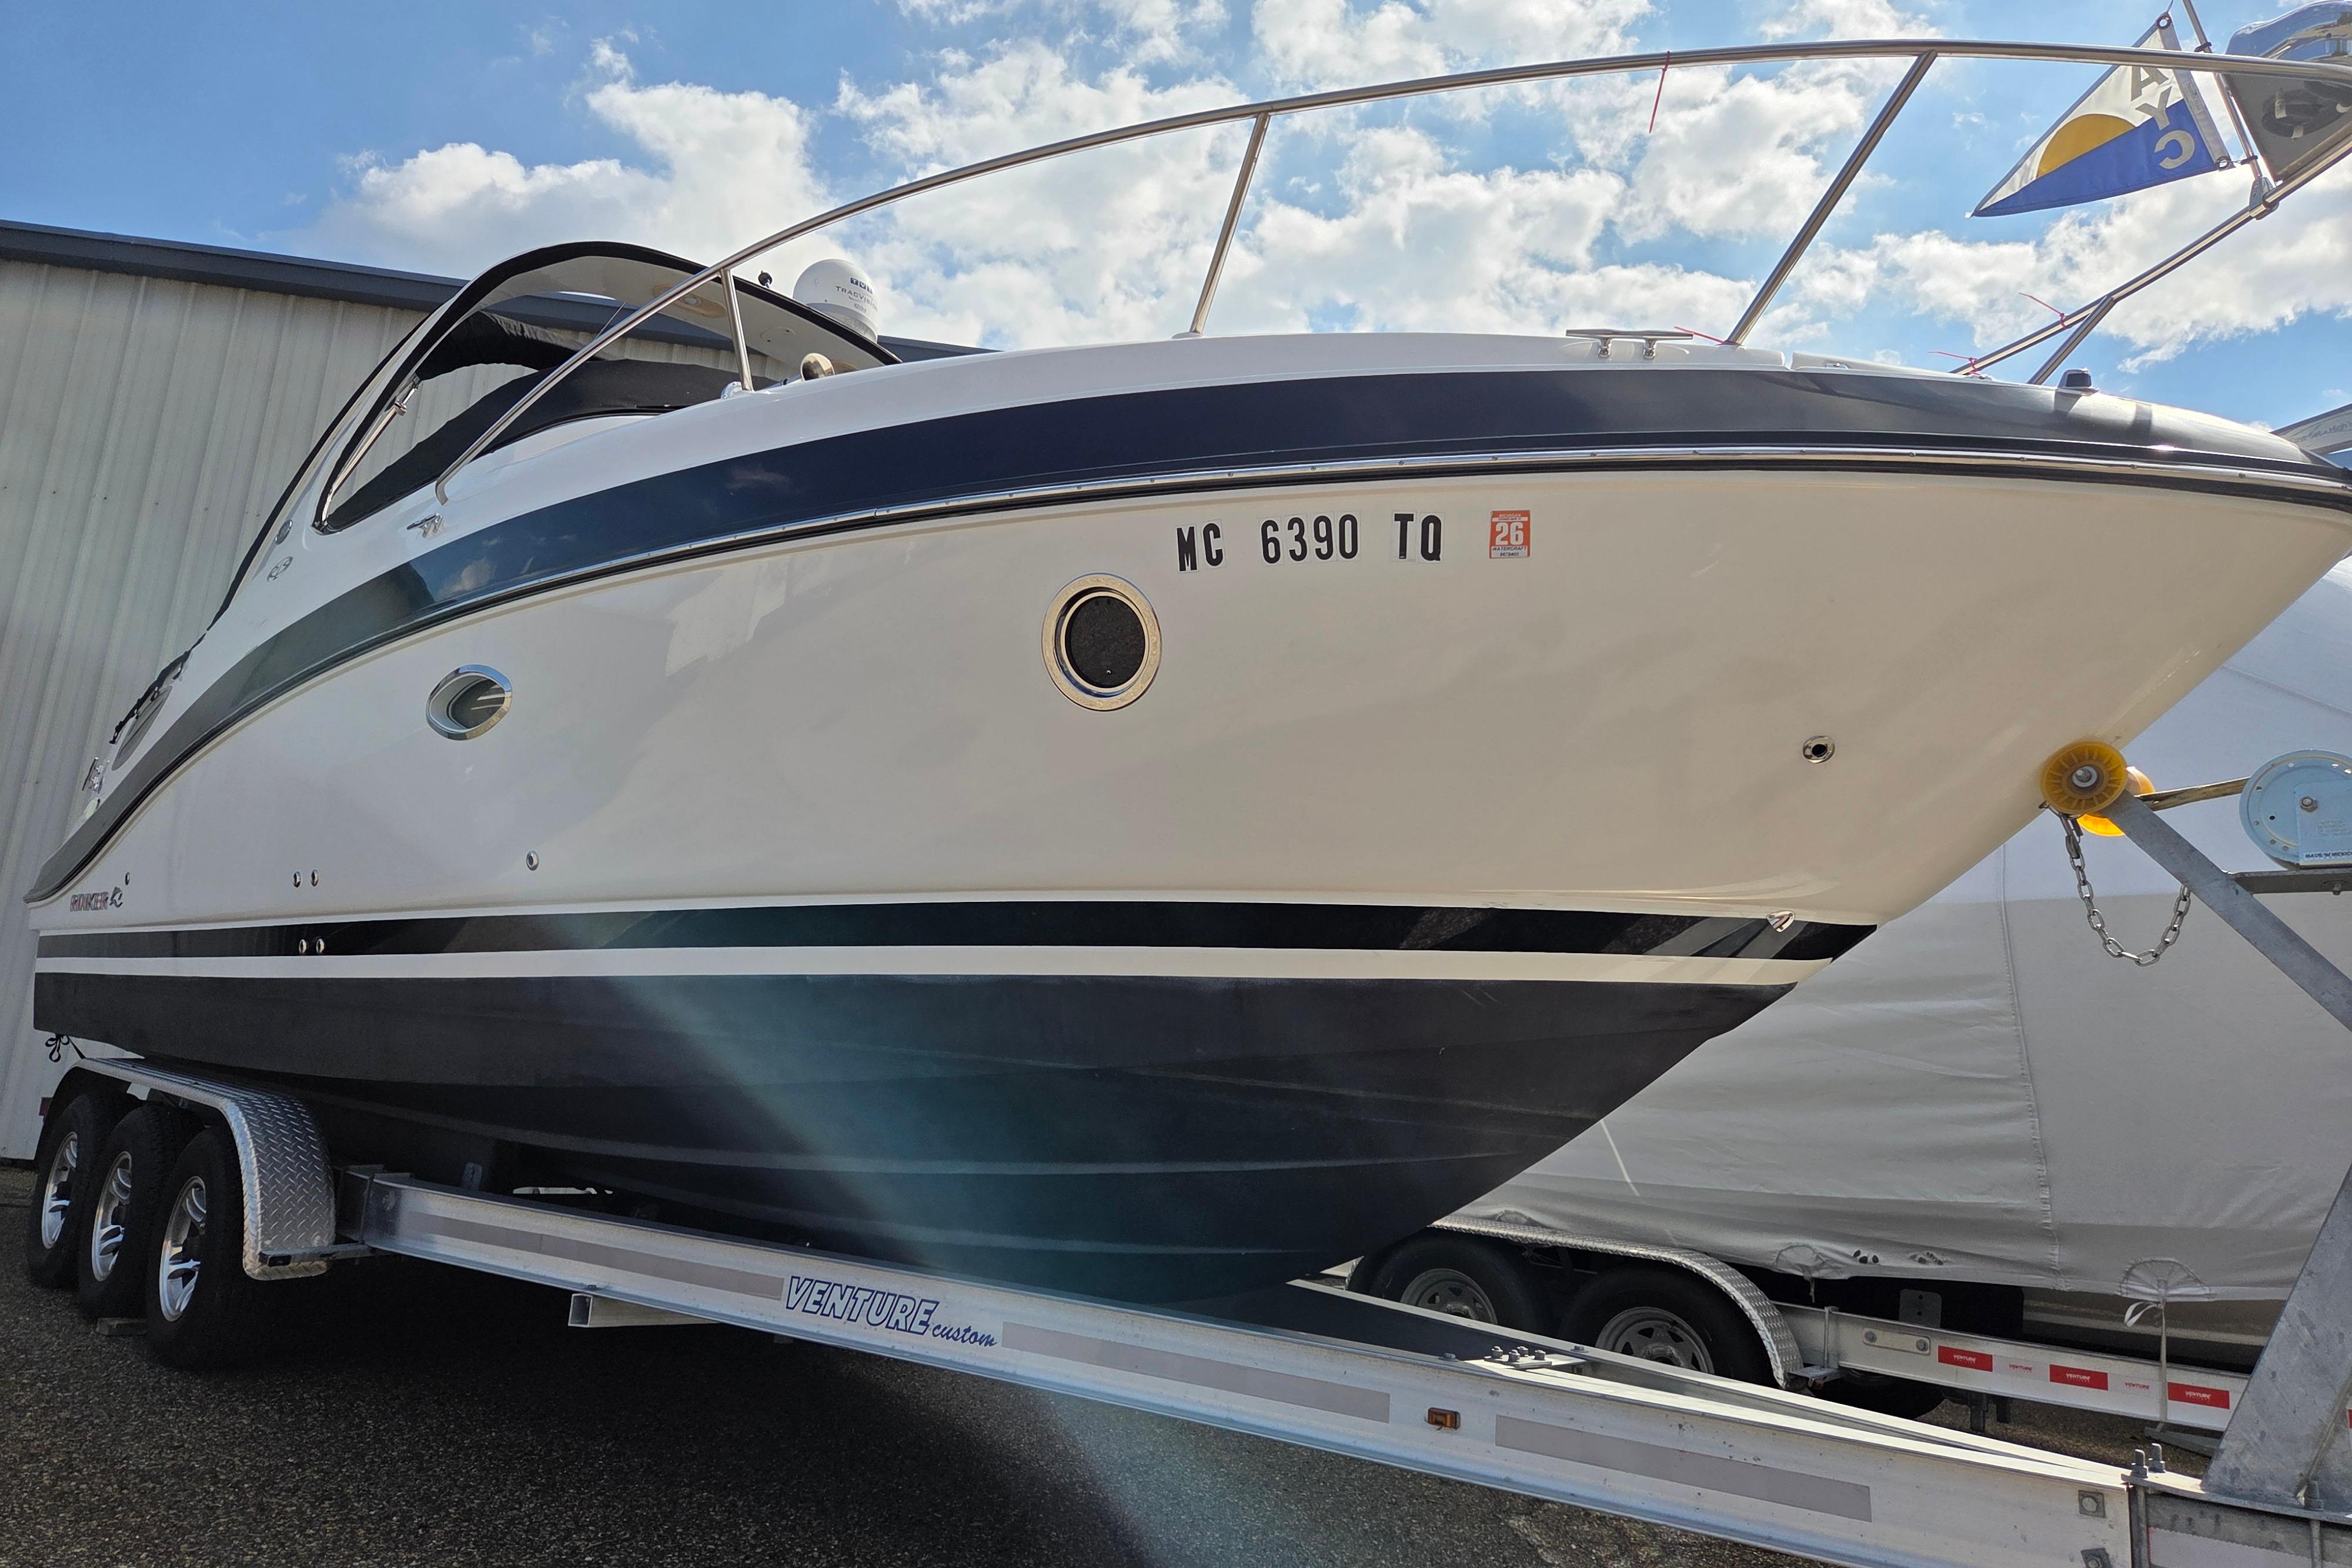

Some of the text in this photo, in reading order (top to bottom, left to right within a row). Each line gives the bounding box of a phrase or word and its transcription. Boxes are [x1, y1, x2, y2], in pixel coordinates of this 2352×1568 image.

[1177, 513, 1442, 571] MC 6390 TQ
[1495, 522, 1524, 546] 26
[786, 1275, 998, 1347] VENTURE custom
